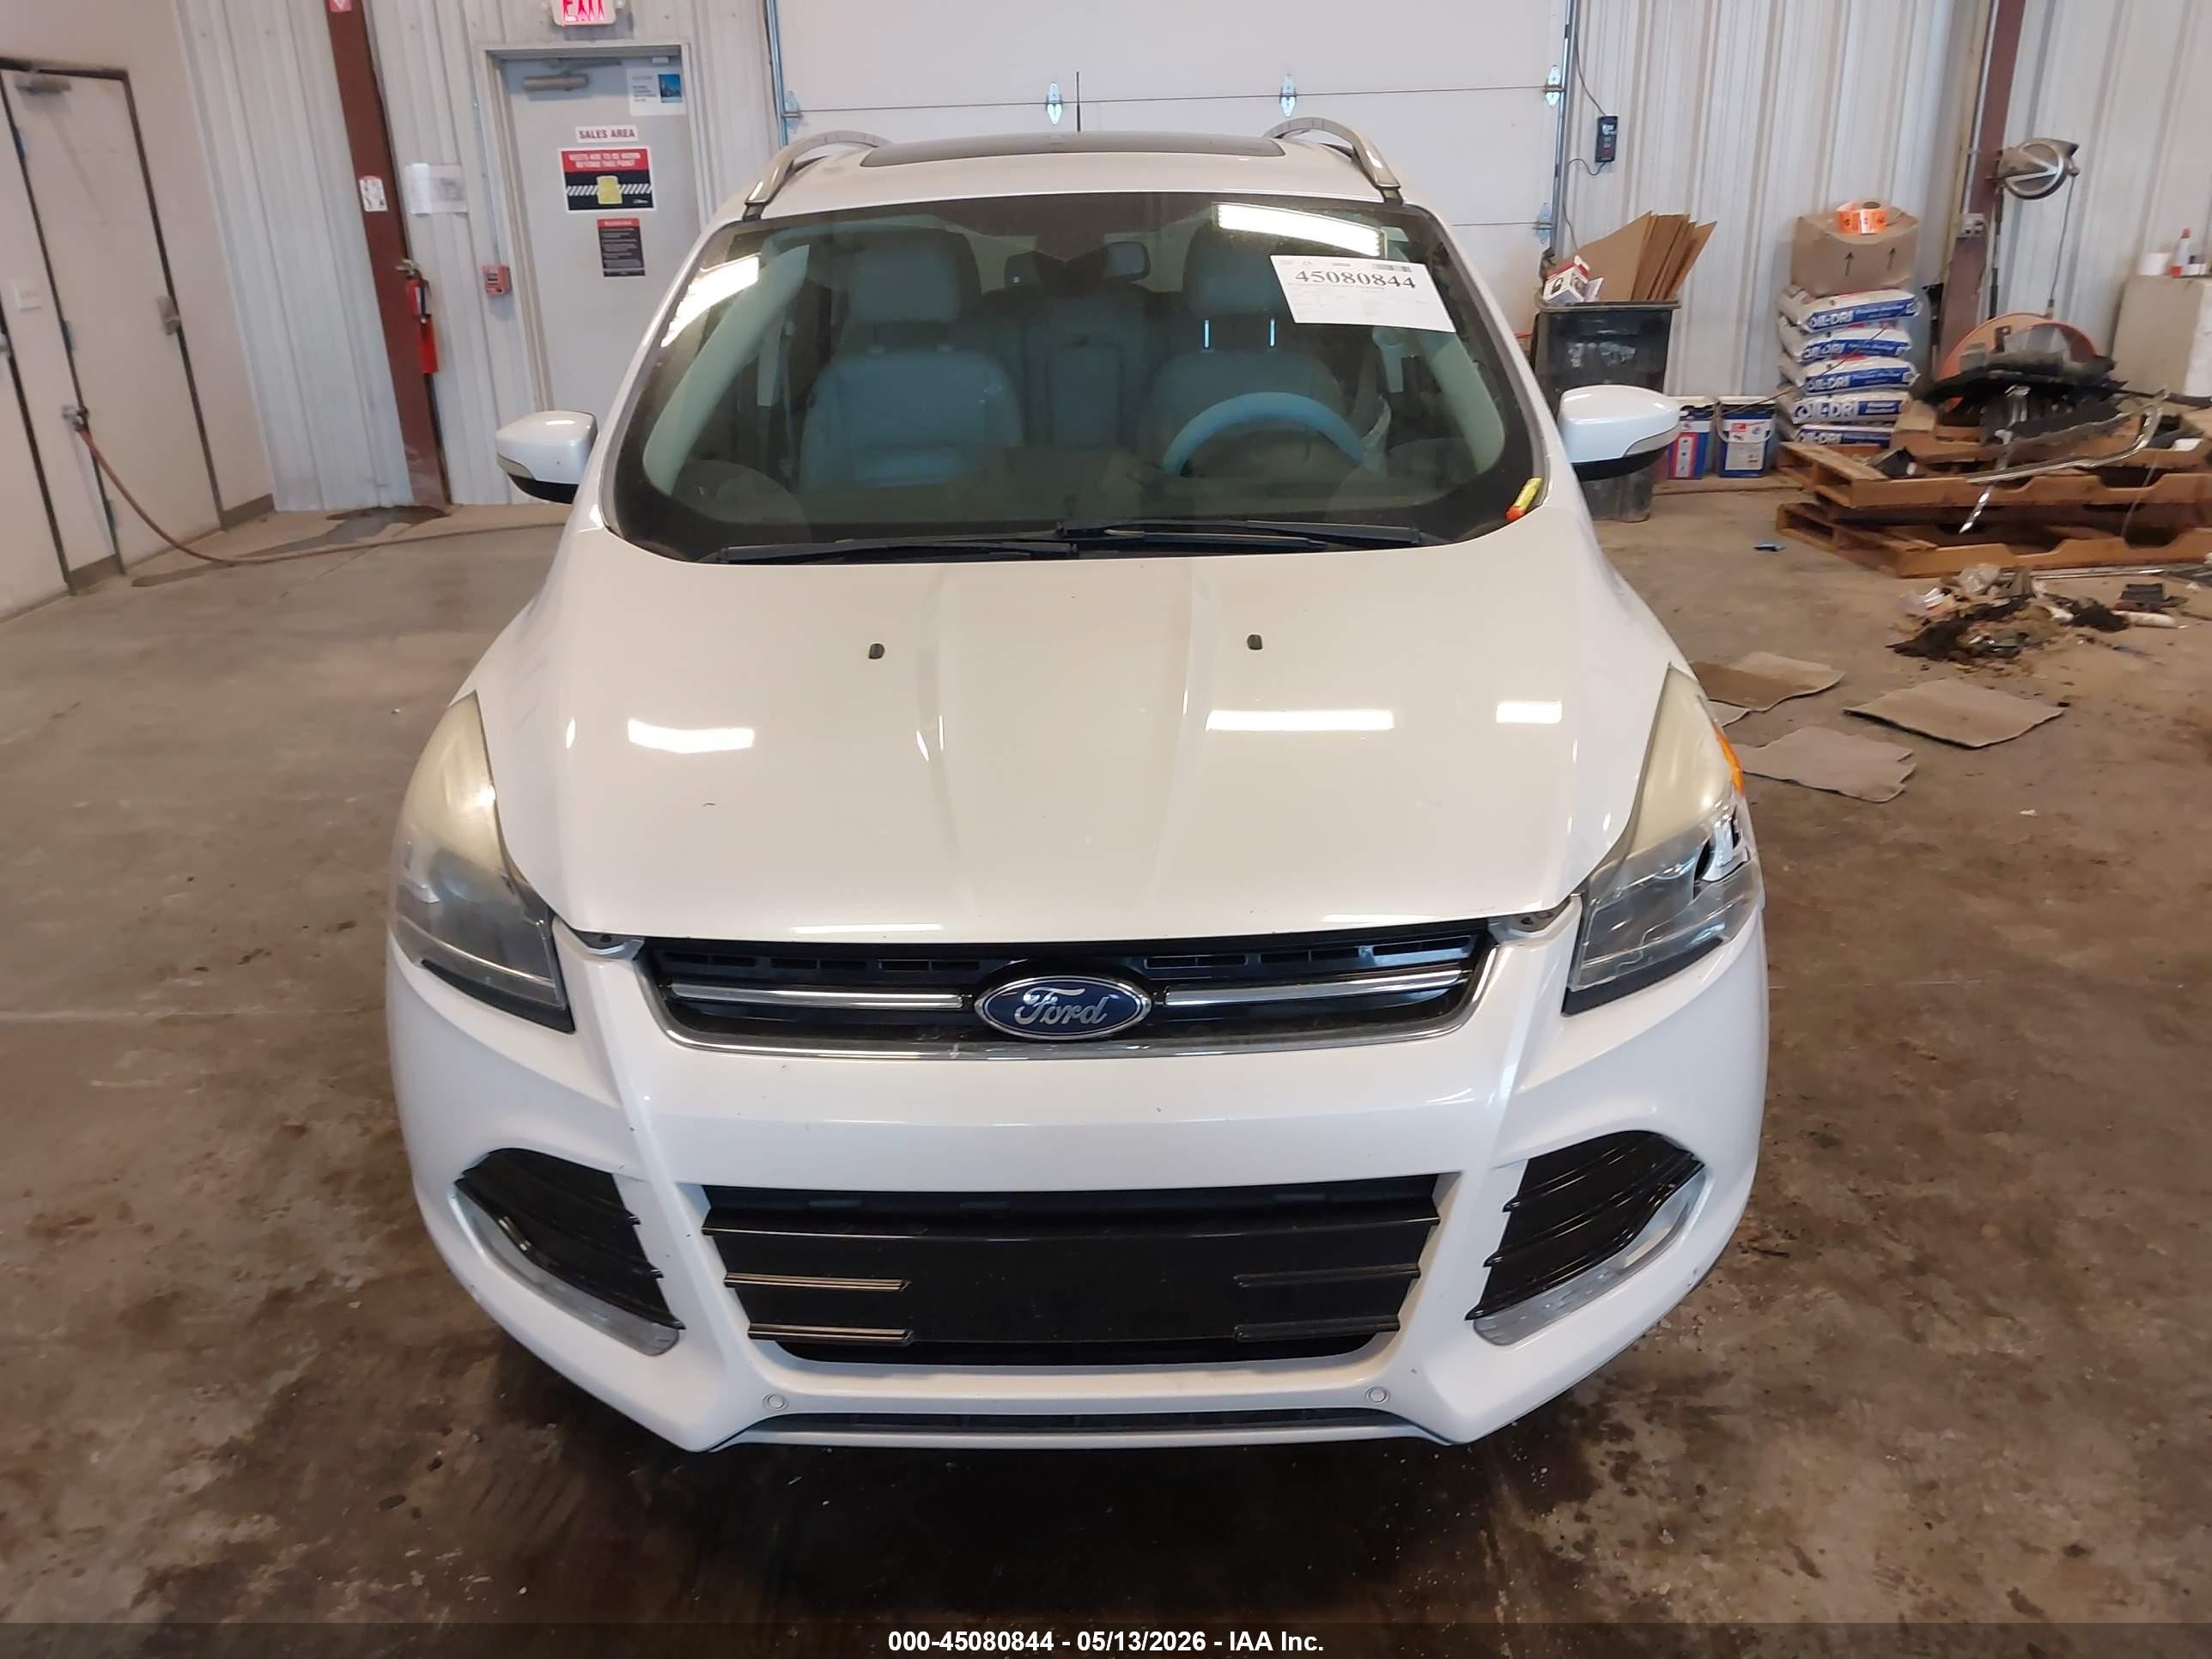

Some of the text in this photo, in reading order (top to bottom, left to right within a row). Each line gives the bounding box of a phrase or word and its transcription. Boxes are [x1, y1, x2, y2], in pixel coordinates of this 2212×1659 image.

[579, 129, 635, 139] SALES AREA
[1295, 270, 1416, 289] 45080844
[1014, 988, 1108, 1024] Ford
